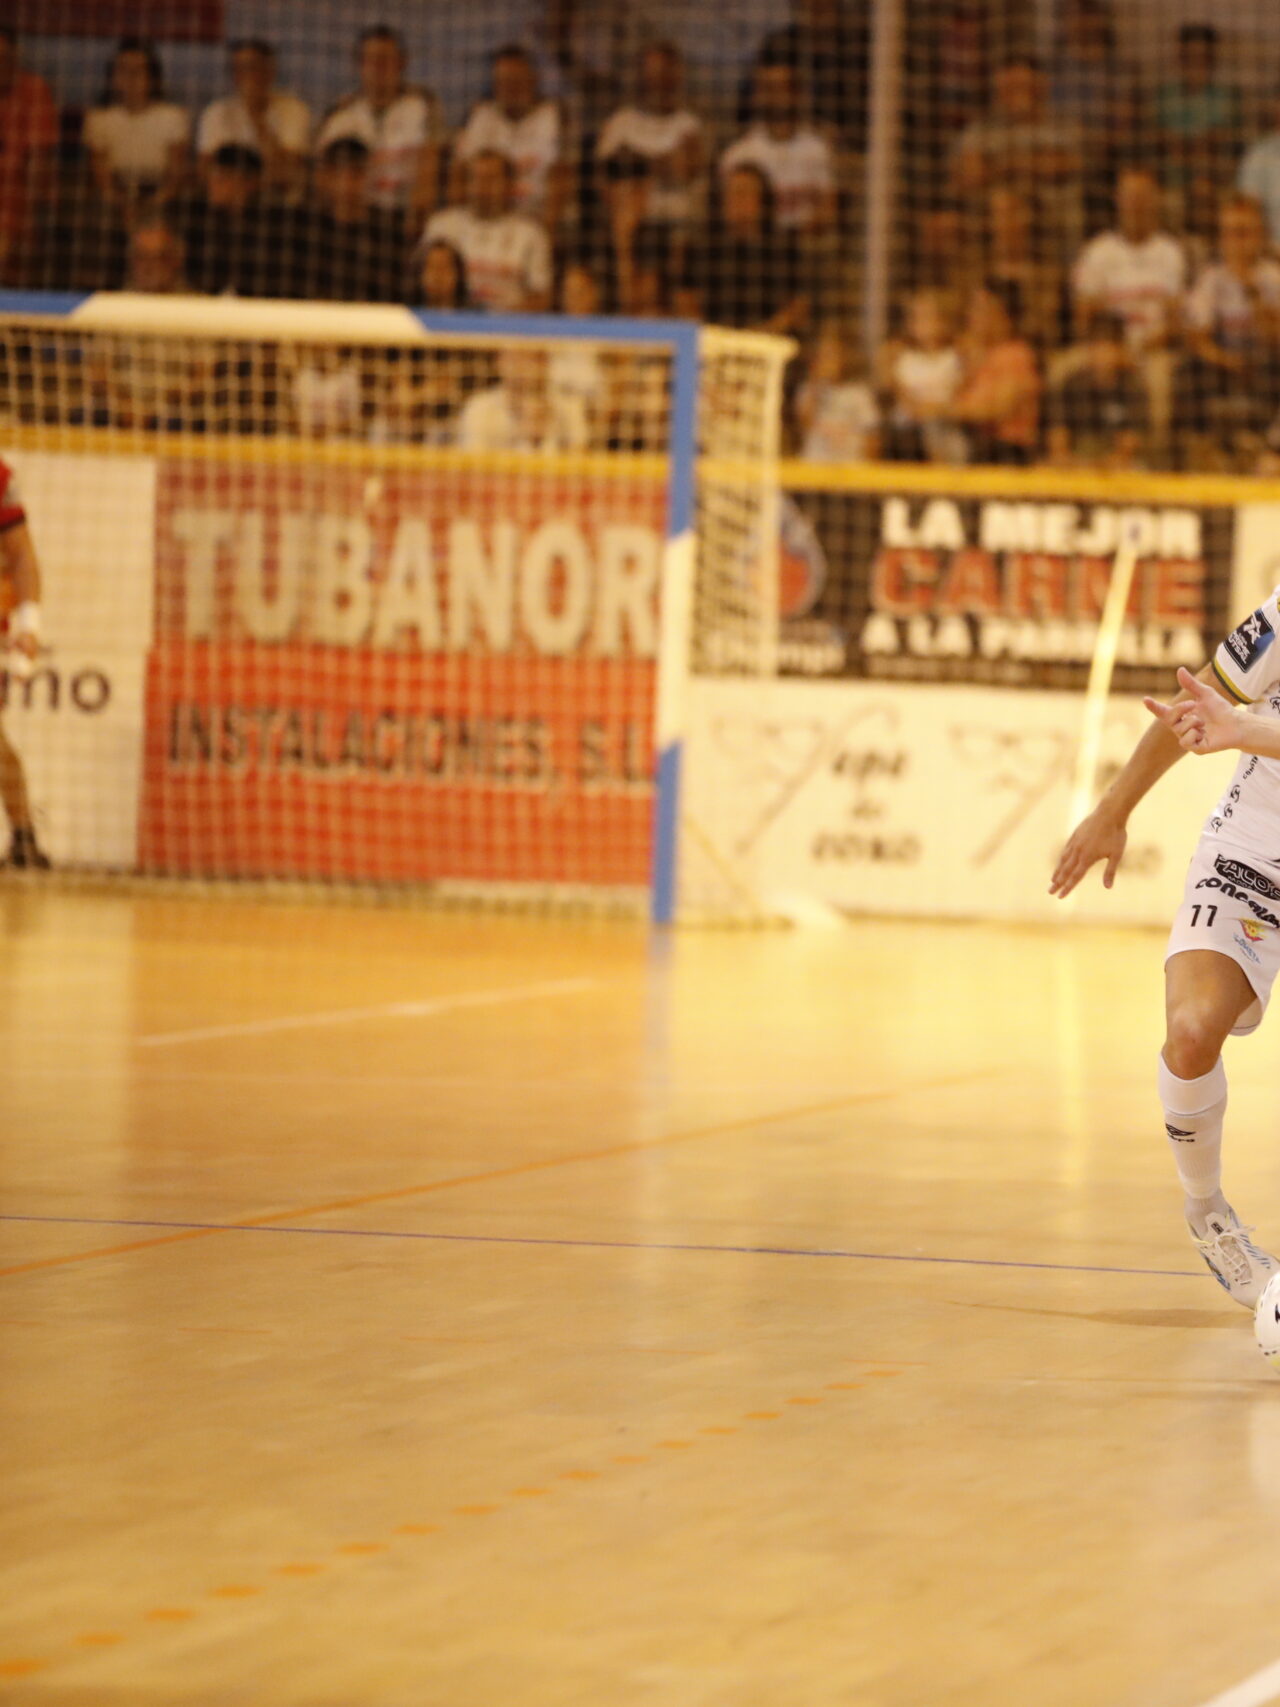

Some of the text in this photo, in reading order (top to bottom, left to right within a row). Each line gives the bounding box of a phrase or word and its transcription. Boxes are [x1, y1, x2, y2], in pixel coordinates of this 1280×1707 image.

[882, 497, 967, 549] LA
[171, 508, 659, 657] TUBANOR
[874, 549, 1206, 621] CARNE
[1190, 904, 1218, 928] 11
